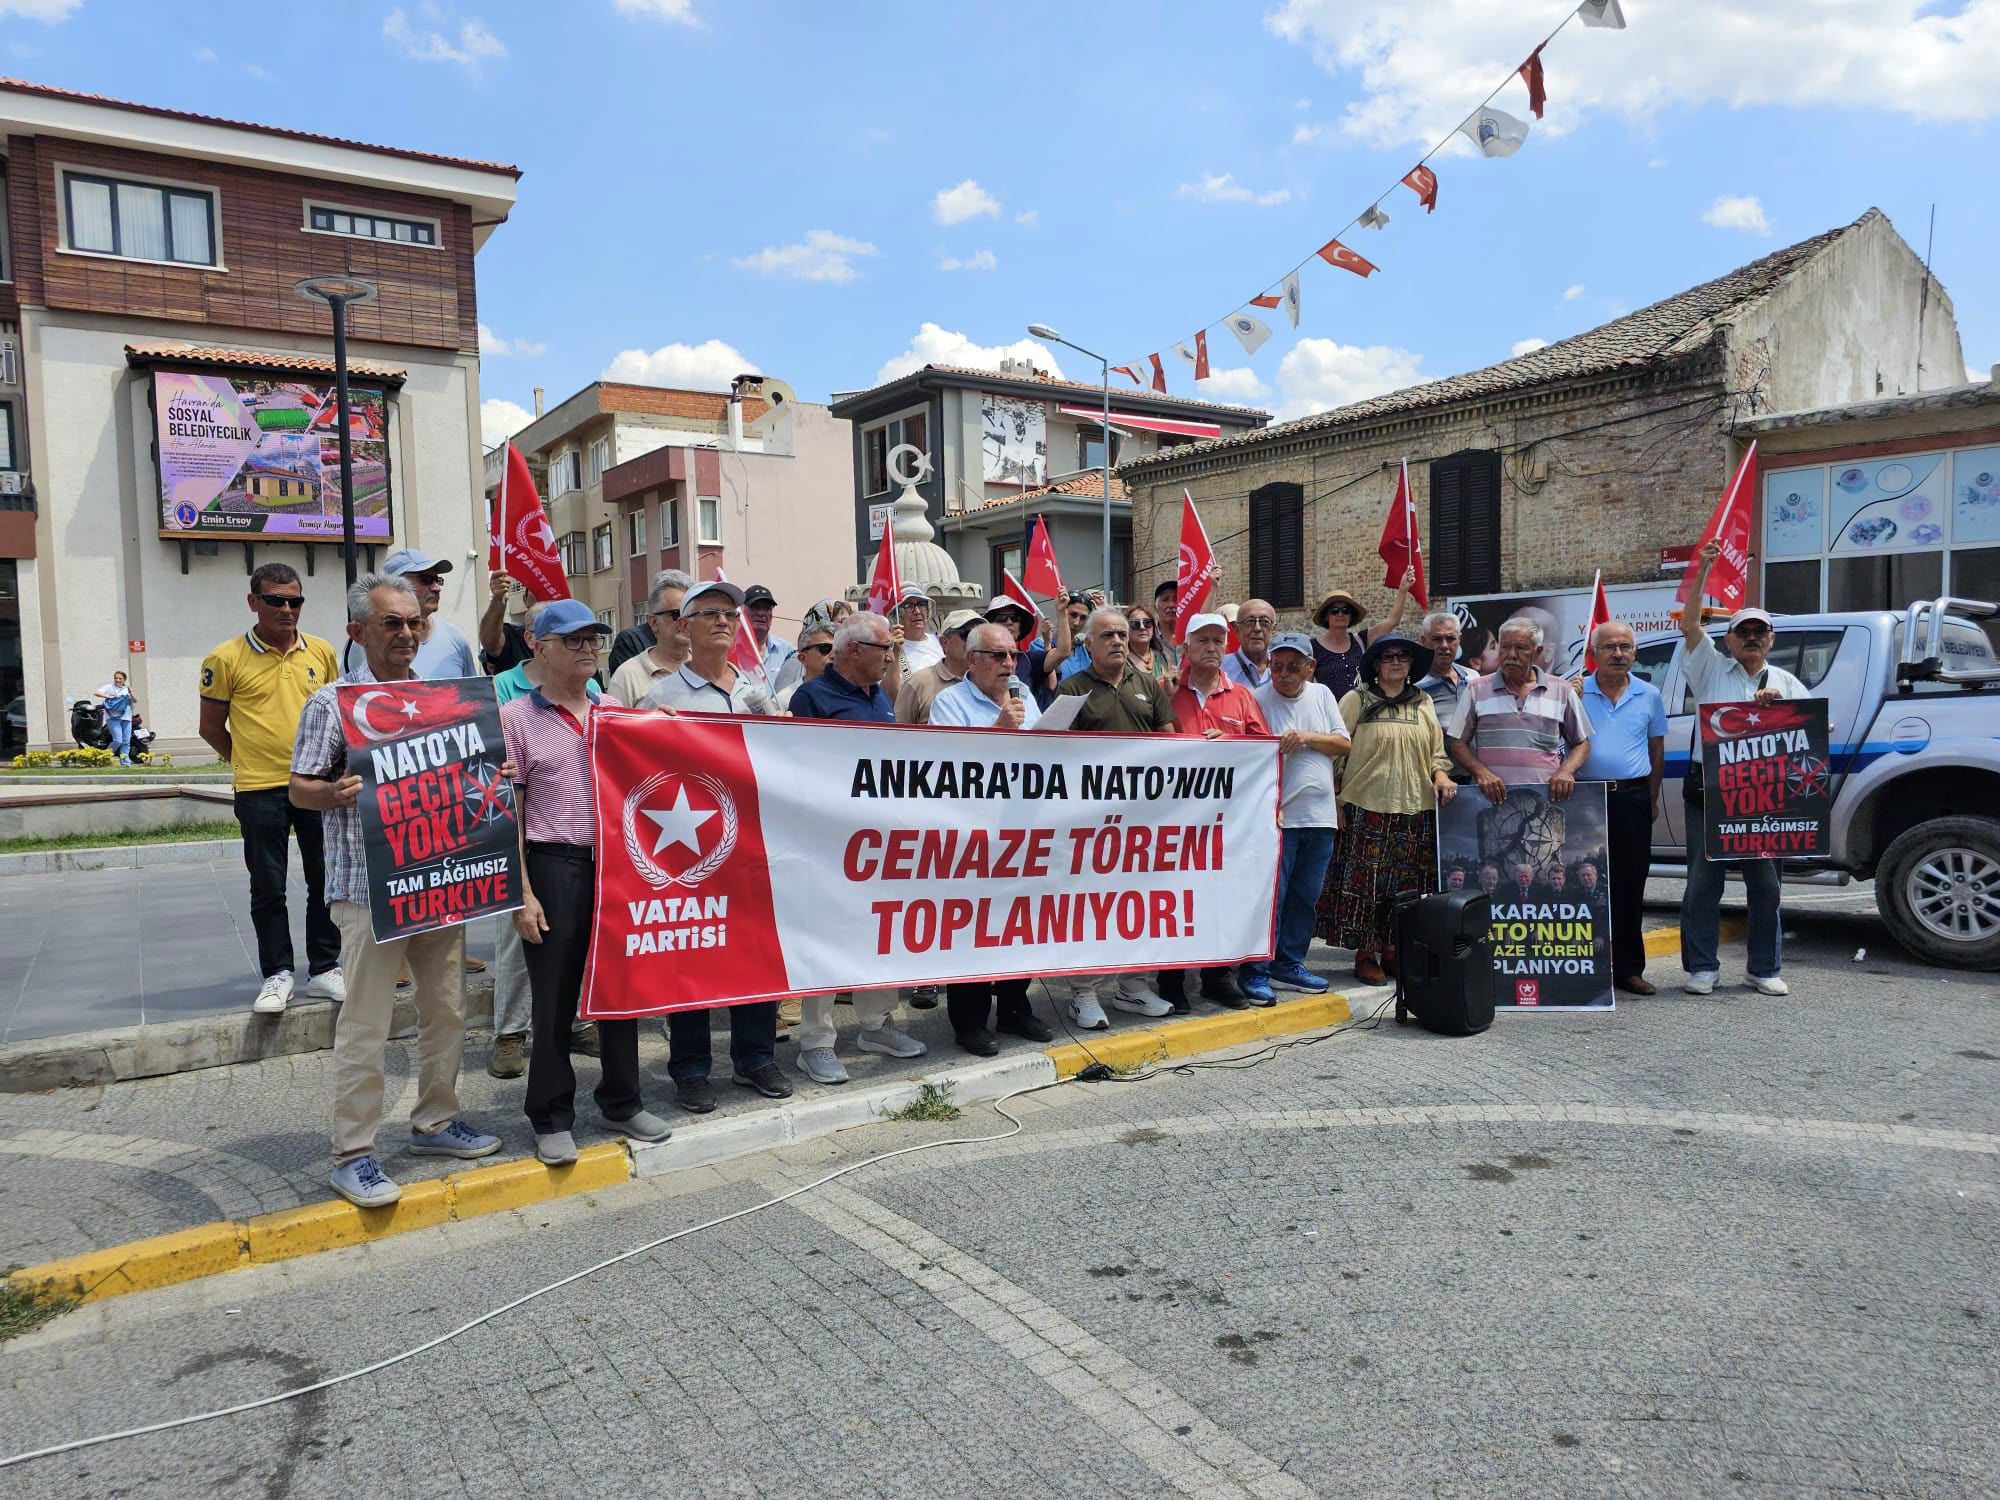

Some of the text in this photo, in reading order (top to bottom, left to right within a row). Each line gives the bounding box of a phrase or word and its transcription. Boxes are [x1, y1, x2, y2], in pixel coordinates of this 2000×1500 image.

[168, 407, 215, 423] SOSYAL
[201, 514, 225, 525] Emin
[226, 516, 251, 527] Ersoy
[202, 668, 213, 687] 3
[371, 723, 486, 784] NATO'YA
[1718, 729, 1810, 765] NATO'YA
[851, 758, 1235, 801] ANKARA'DA NATO'NUN
[1721, 782, 1785, 817] YOK!
[384, 804, 467, 868] YOK!
[1718, 820, 1818, 834] TAM BAĞIMSIZ
[844, 812, 1224, 882] CENAZE TÖRENİ
[387, 857, 508, 897] TAM BAĞIMSIZ
[628, 895, 728, 926] VATAN
[871, 889, 1195, 956] TOPLANIYOR!
[1491, 903, 1592, 920] KARA'DA
[1493, 942, 1594, 957] AZE TÖRENİ
